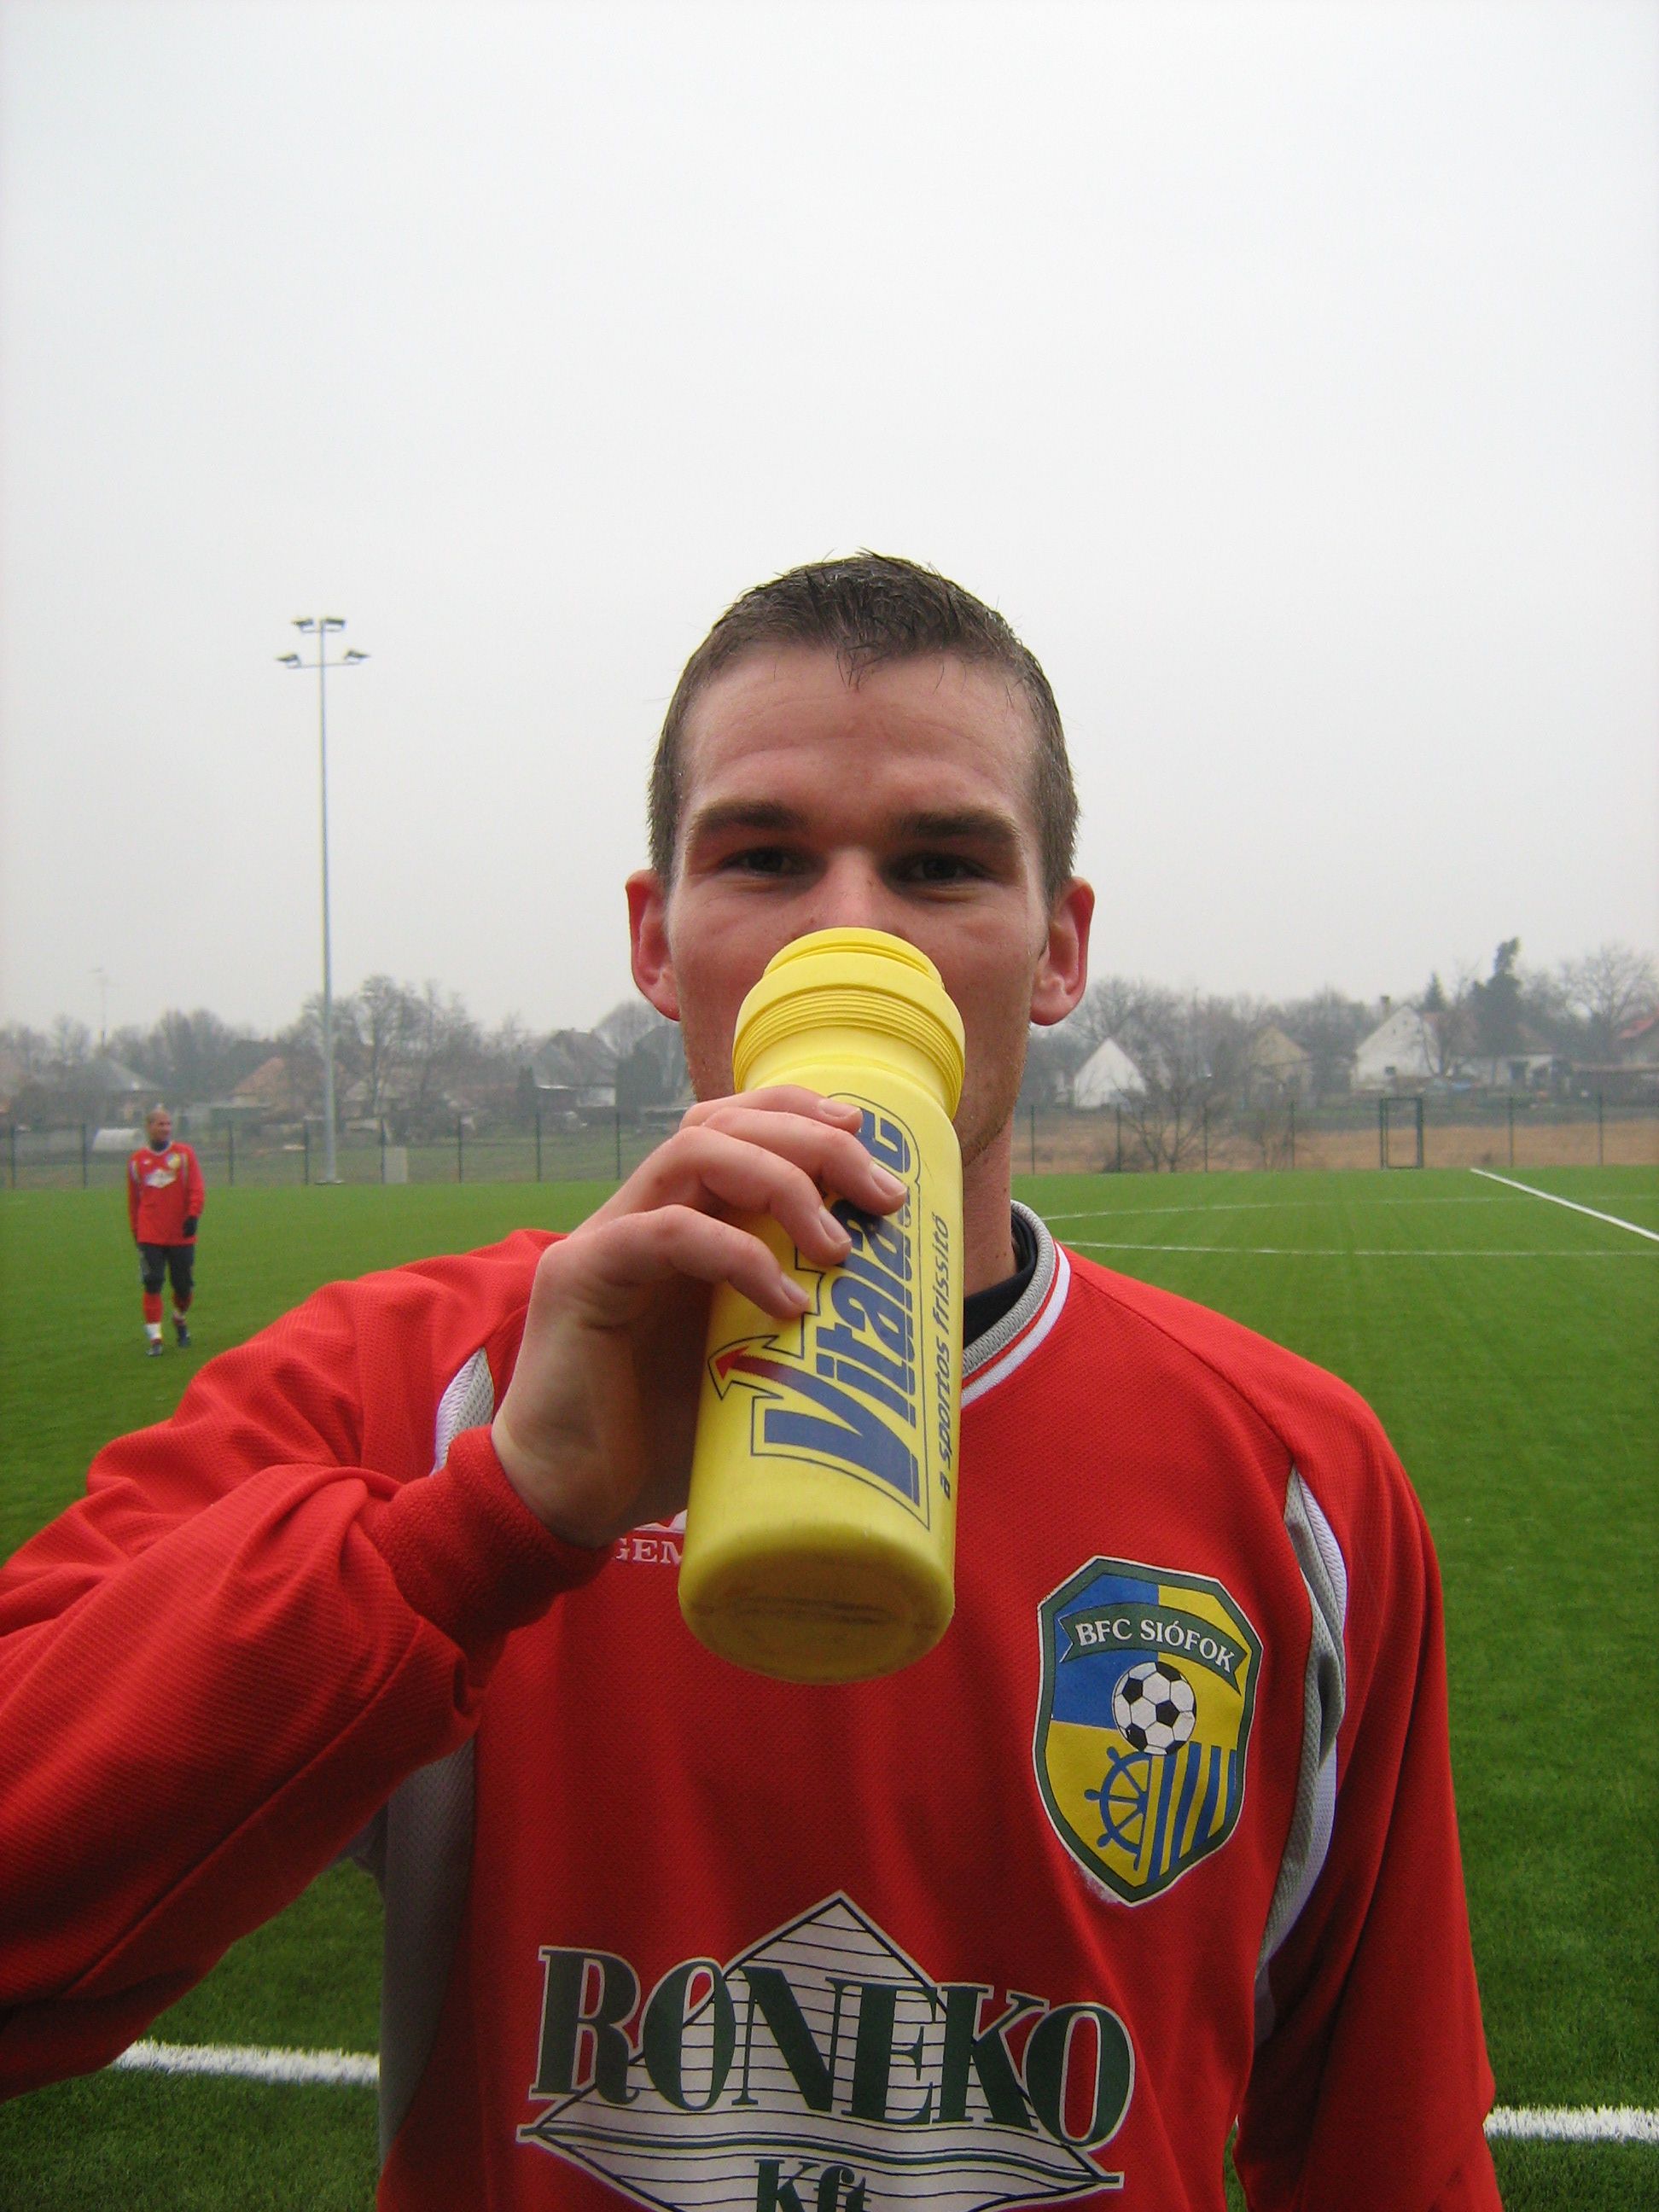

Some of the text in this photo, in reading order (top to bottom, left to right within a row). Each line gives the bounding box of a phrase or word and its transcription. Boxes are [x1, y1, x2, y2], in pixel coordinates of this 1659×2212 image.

[761, 1110, 919, 1506] Vitalae
[934, 1336, 952, 1469] sportos
[940, 1471, 950, 1499] a
[1075, 1619, 1234, 1674] BFC SIÓFOK
[531, 1947, 1135, 2147] RONEKO
[754, 2158, 872, 2212] Kft
